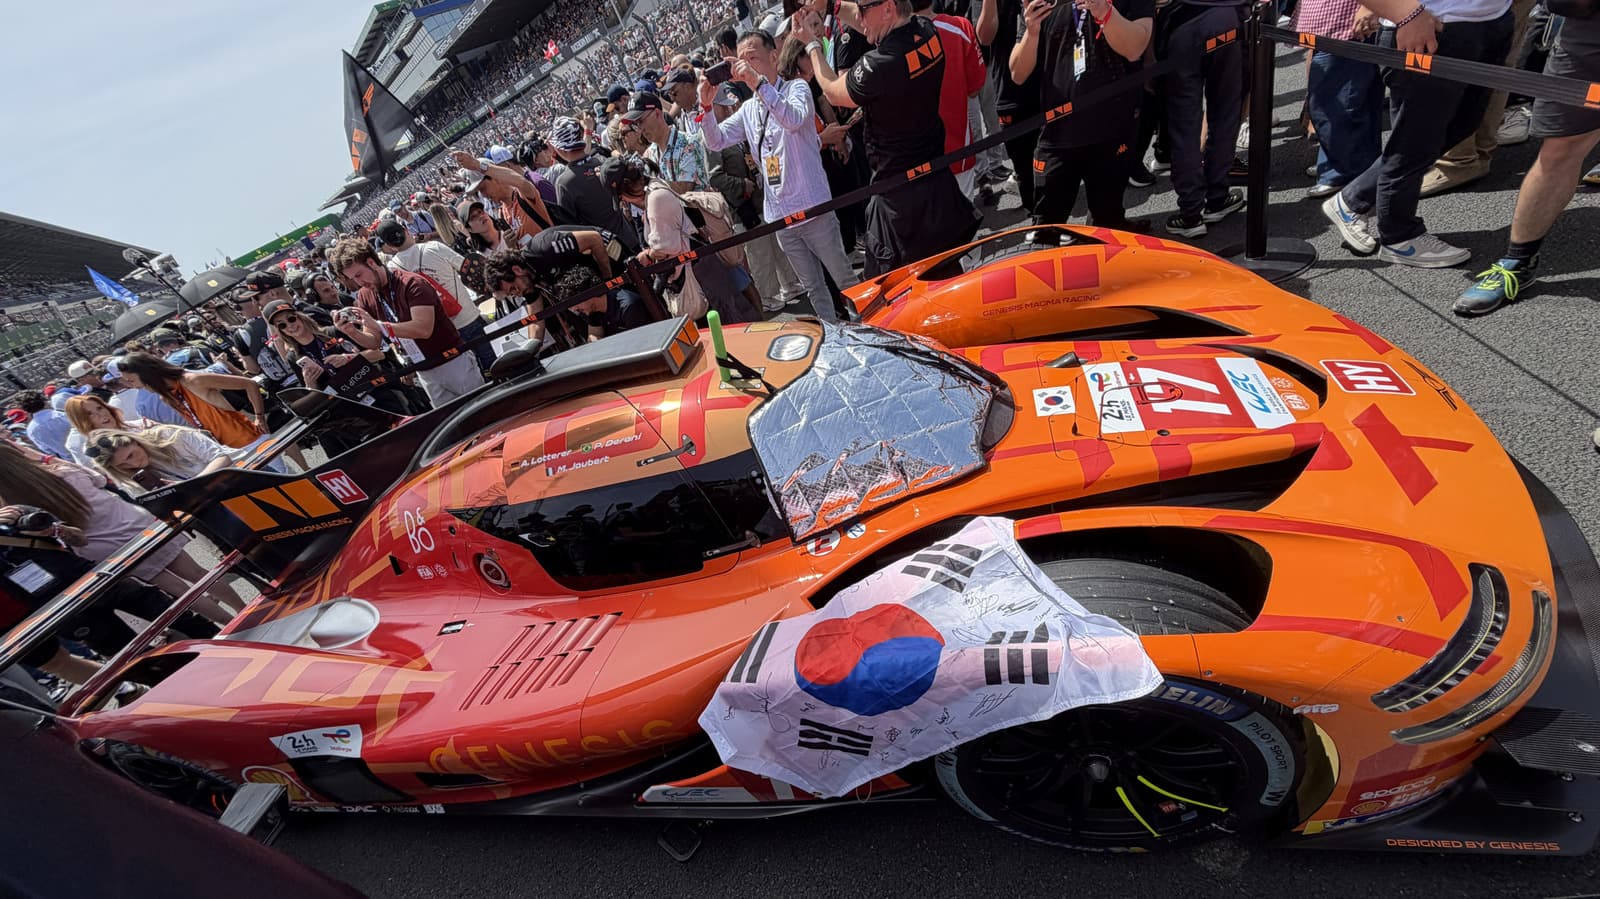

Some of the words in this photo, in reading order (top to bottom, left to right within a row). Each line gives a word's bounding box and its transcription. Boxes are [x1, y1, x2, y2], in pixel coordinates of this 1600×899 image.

[983, 305, 1024, 317] GENESIS
[1025, 299, 1061, 310] MAGMA
[1062, 294, 1100, 303] RACING
[349, 365, 370, 386] GROUP
[1335, 362, 1400, 391] HY
[1137, 367, 1232, 415] 17
[324, 476, 357, 499] HY
[262, 528, 294, 542] GENESIS
[1248, 721, 1275, 747] PILOT
[1270, 744, 1288, 771] SPORT
[1360, 776, 1436, 801] sparco
[1386, 839, 1464, 848] DESIGNED
[1465, 841, 1486, 849] BY
[1489, 841, 1561, 851] GENESIS
